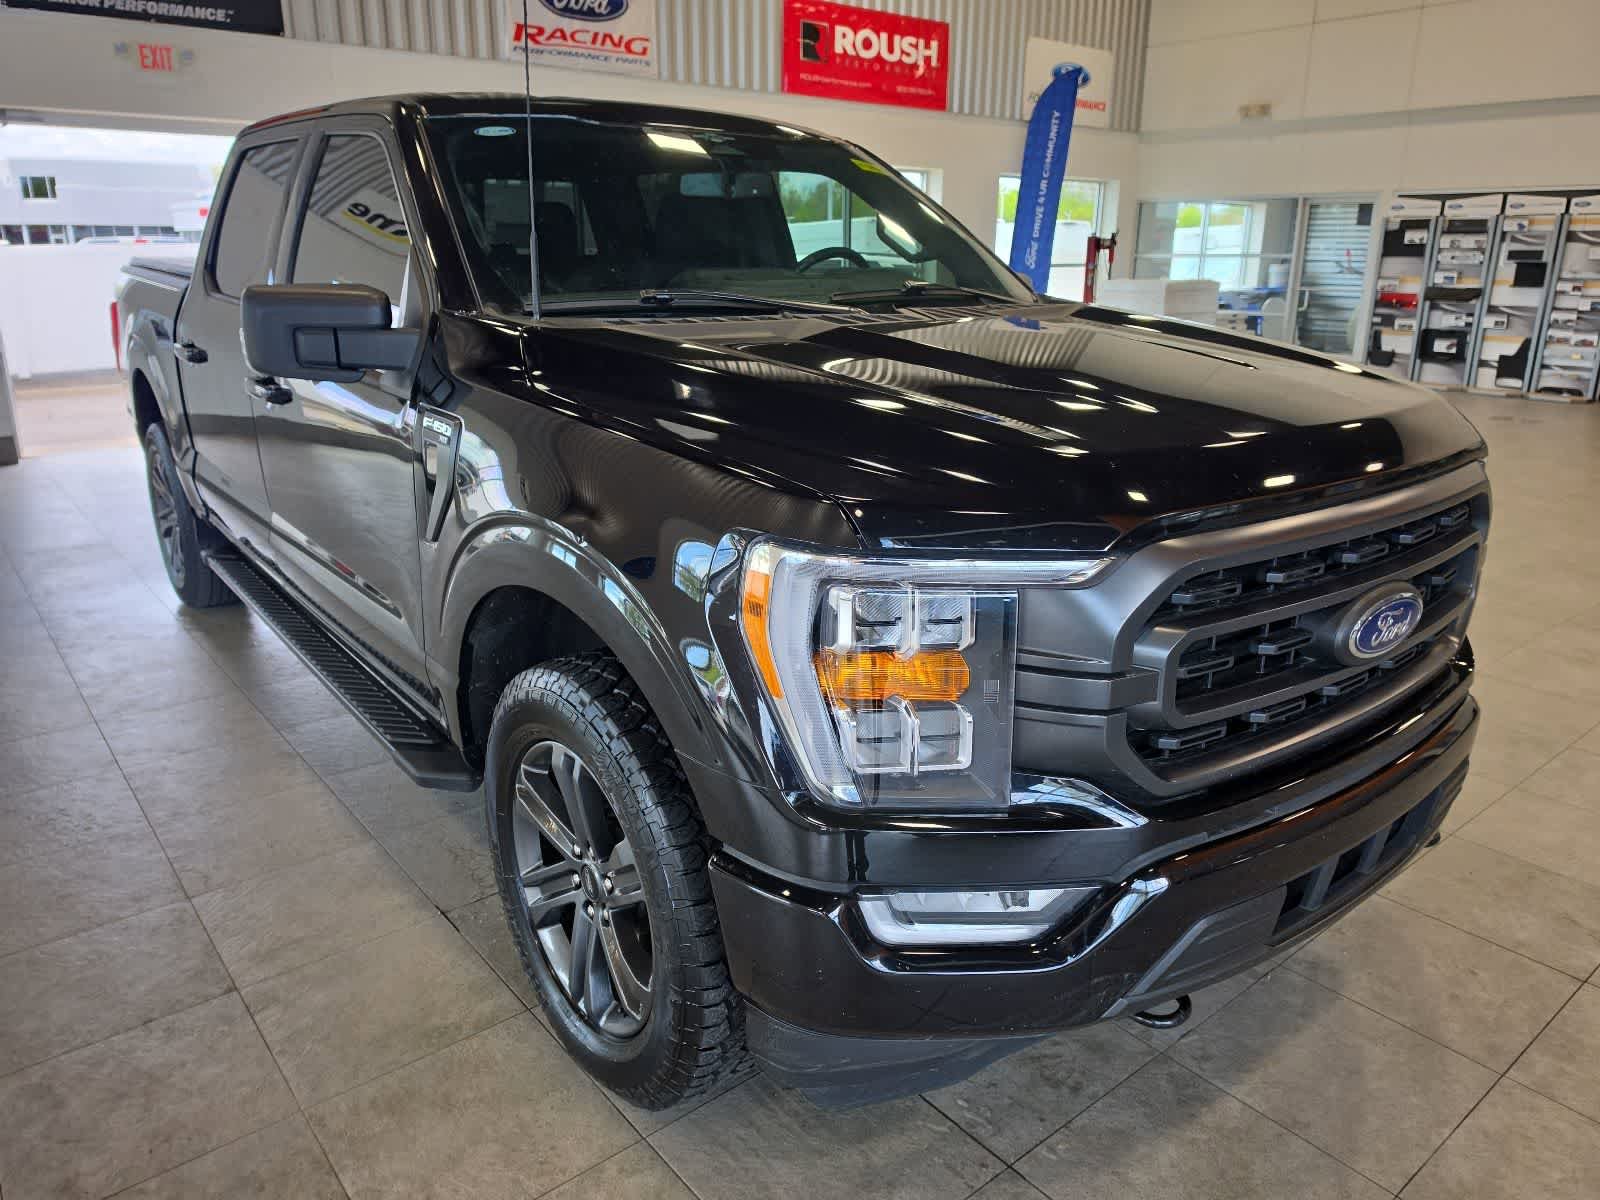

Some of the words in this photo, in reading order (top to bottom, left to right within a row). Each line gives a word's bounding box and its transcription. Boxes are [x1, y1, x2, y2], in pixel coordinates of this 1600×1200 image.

[138, 43, 174, 71] EXIT
[513, 22, 649, 56] RACING
[834, 23, 939, 71] ROUSH
[1025, 240, 1038, 269] Ford
[1032, 205, 1044, 237] DRIVE
[1039, 179, 1048, 195] UR
[1371, 607, 1411, 647] Ford
